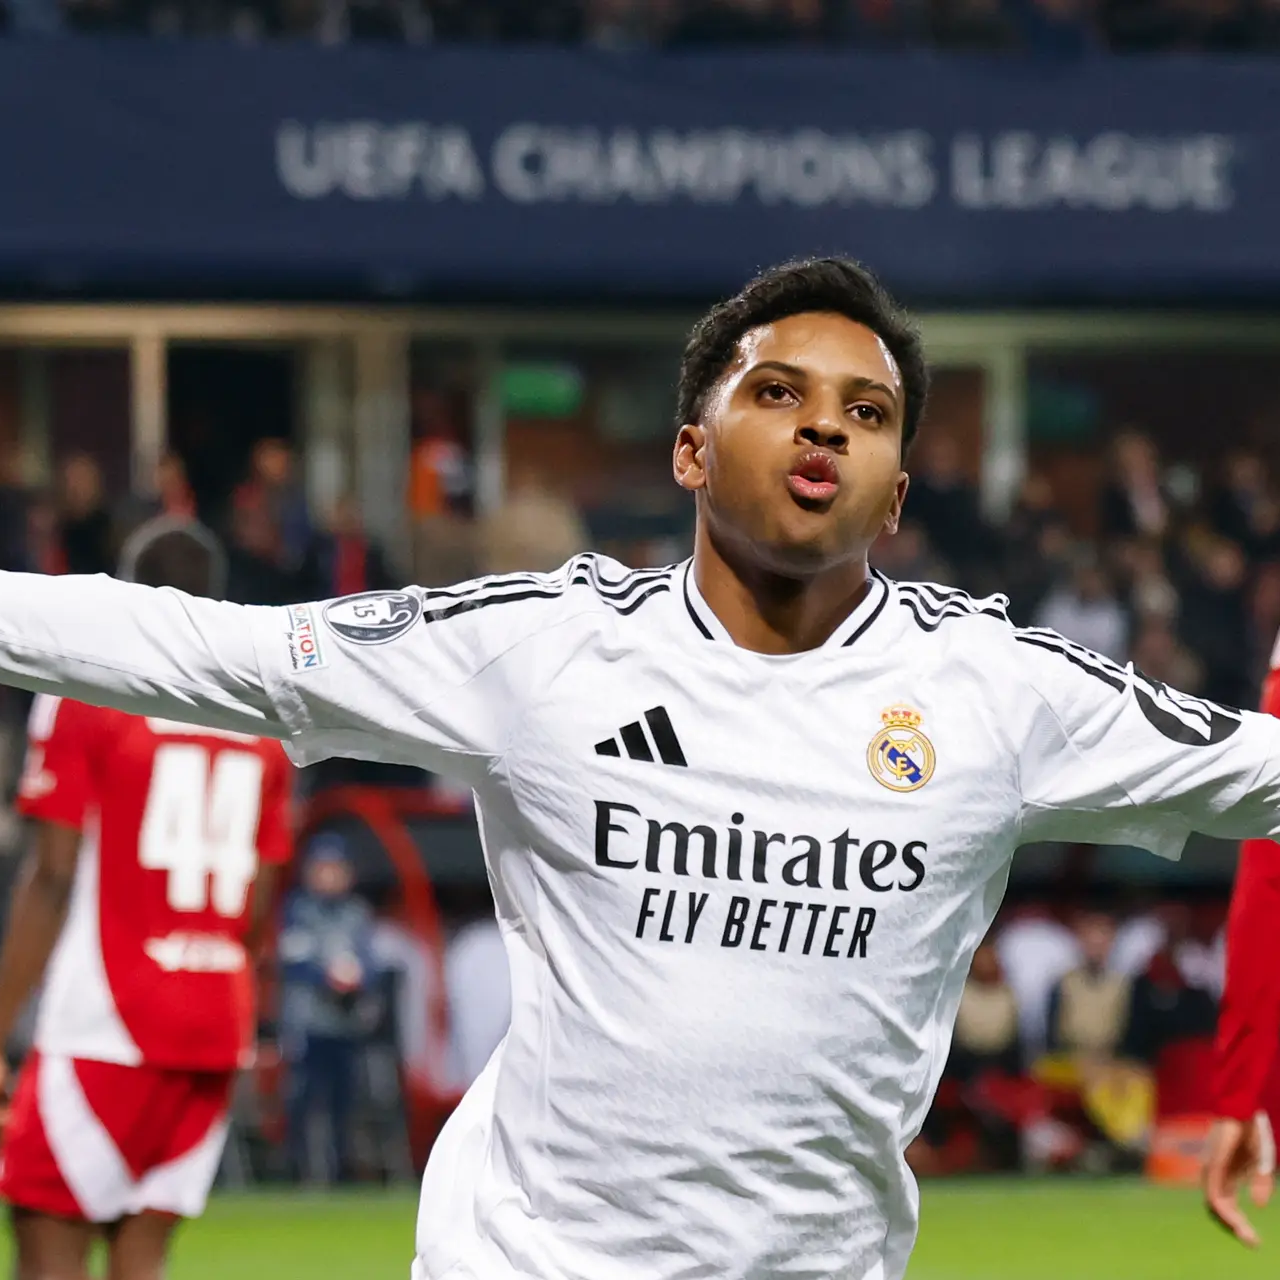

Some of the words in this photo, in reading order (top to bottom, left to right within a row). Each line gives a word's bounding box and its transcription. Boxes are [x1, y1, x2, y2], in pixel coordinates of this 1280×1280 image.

[276, 119, 485, 202] UEFA
[491, 122, 936, 211] CHAMPIONS
[950, 131, 1235, 213] LEAGUE
[352, 604, 377, 619] 15
[137, 742, 264, 919] 44
[593, 799, 928, 893] Emirates
[635, 888, 710, 944] FLY
[720, 896, 877, 959] BETTER
